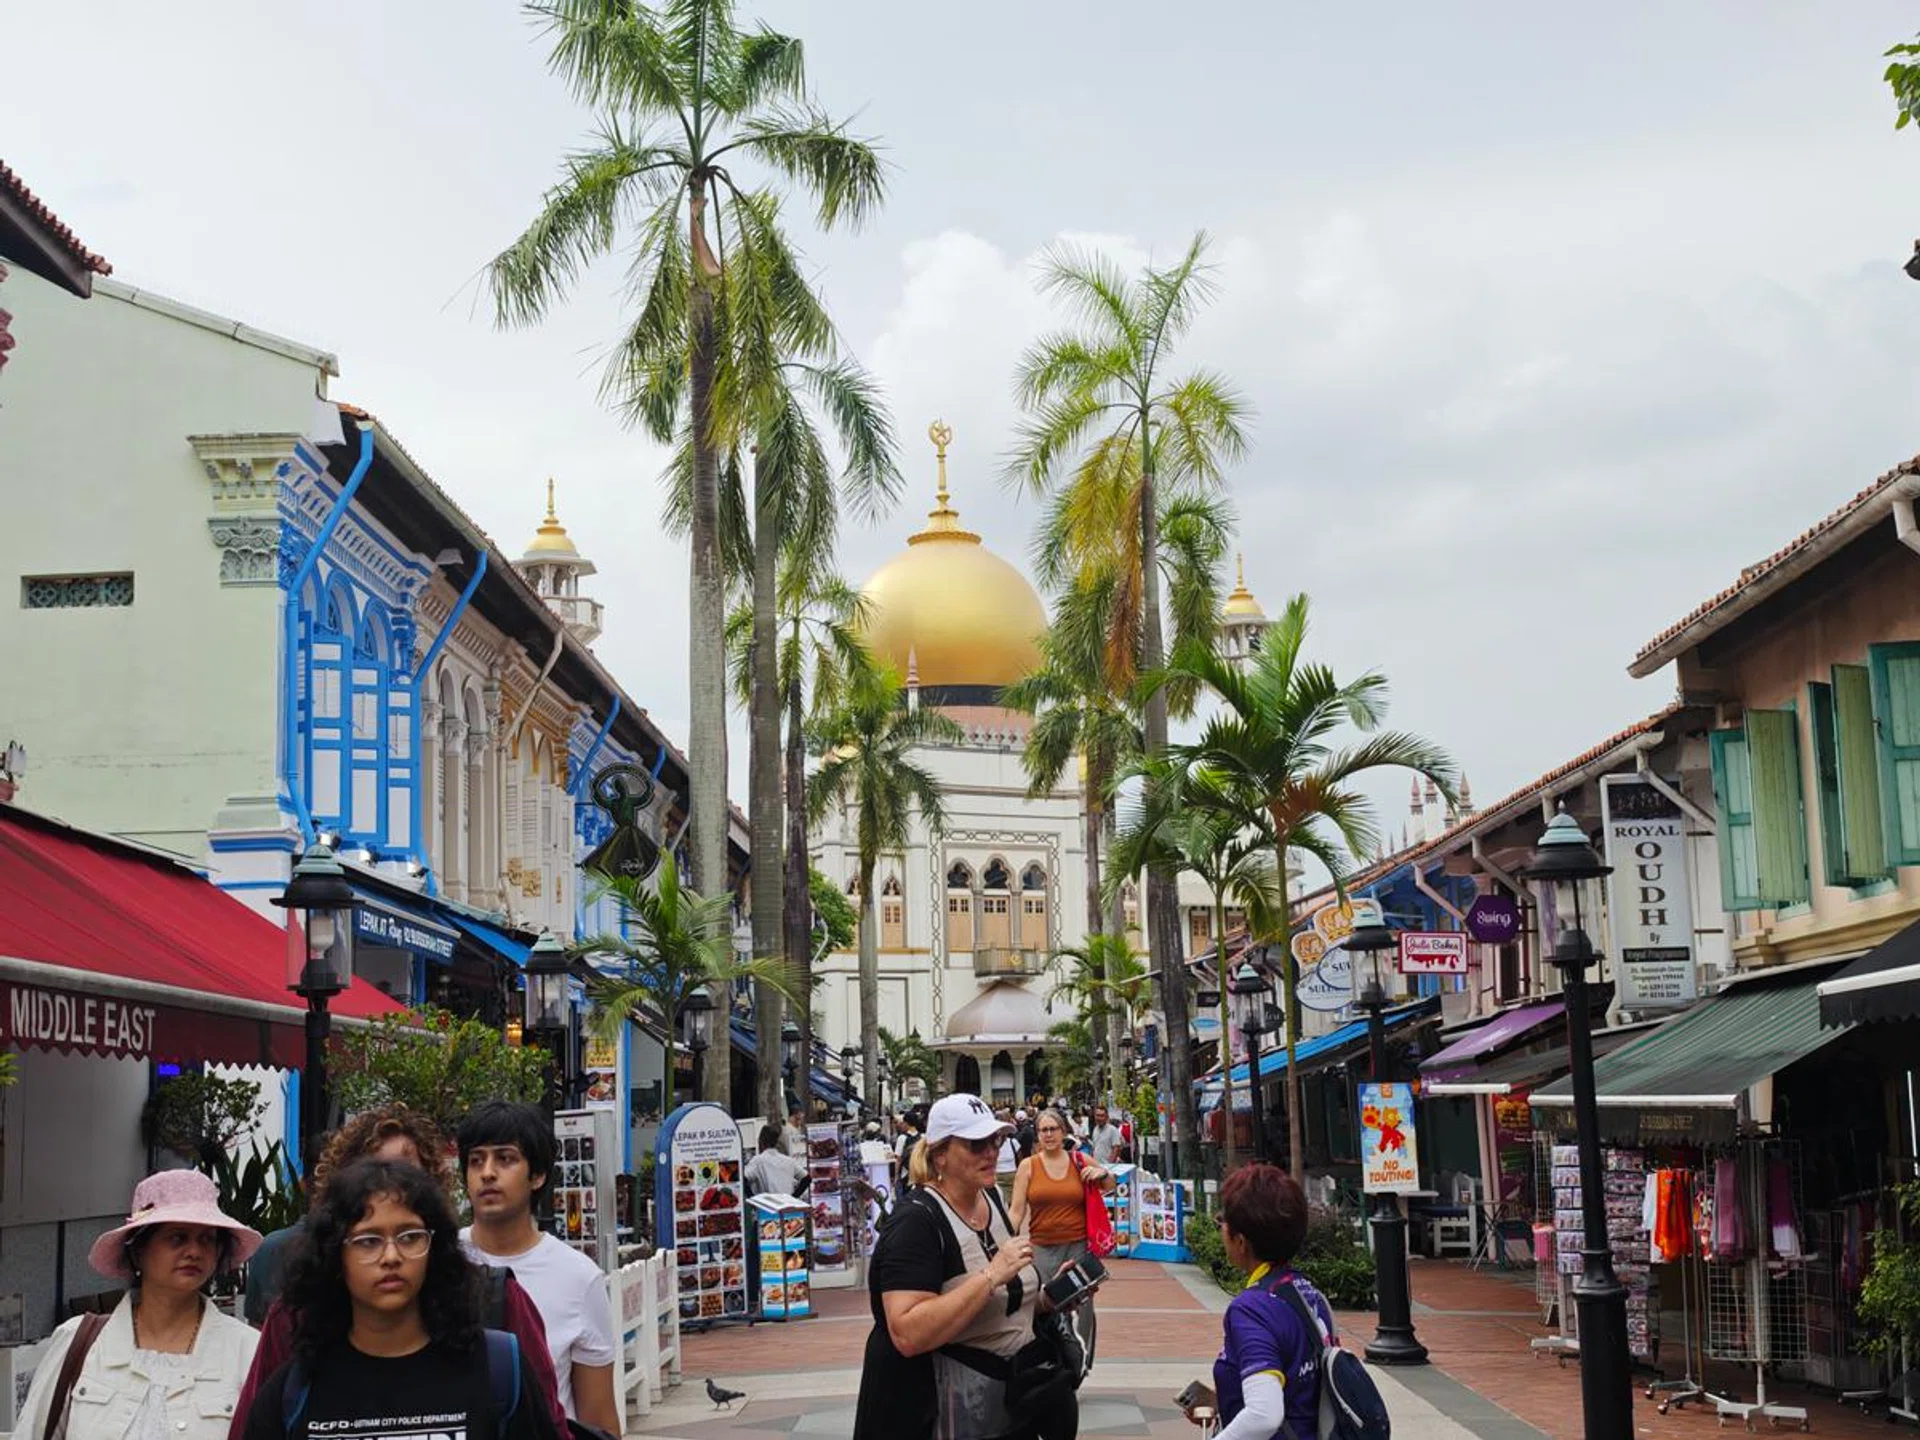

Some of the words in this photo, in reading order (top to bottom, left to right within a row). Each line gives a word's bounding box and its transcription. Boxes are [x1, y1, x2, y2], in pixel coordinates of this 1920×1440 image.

[1615, 825, 1680, 837] ROYAL
[1635, 841, 1668, 926] OUDH
[1477, 910, 1511, 928] Swing
[1649, 932, 1661, 945] By
[11, 987, 98, 1045] MIDDLE
[104, 1001, 156, 1051] EAST
[674, 1130, 698, 1141] LEPAK
[707, 1127, 737, 1138] SULTAN
[1383, 1160, 1399, 1170] NO
[1370, 1170, 1416, 1183] TOUTING!
[354, 1418, 381, 1428] GOTHAM
[382, 1416, 397, 1427] CITY
[398, 1415, 422, 1426] POLICE
[422, 1412, 467, 1424] DEPARTMENT
